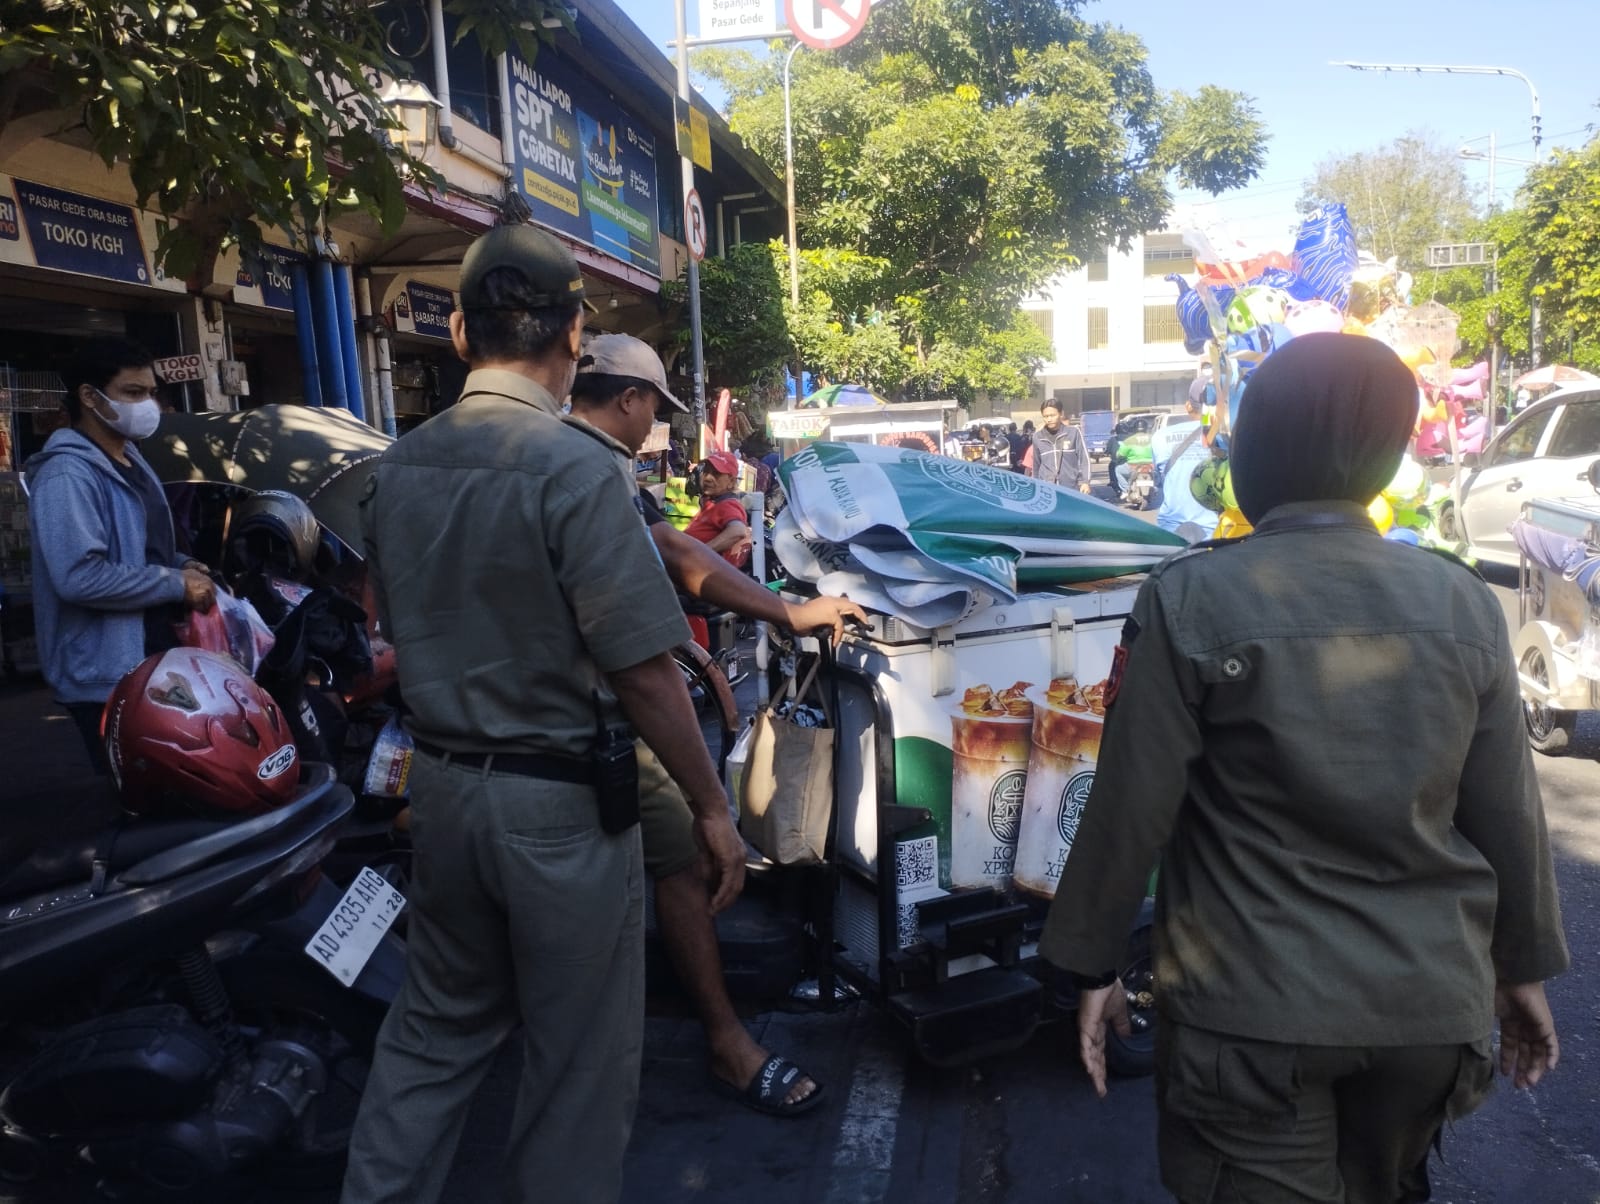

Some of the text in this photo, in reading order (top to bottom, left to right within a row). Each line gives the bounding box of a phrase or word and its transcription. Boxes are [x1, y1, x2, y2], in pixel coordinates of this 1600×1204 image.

[711, 13, 764, 28] Pasar Gede
[512, 56, 573, 114] MAU LAPOR
[515, 82, 553, 140] SPT
[518, 129, 577, 184] CORETAX
[28, 193, 129, 227] PASAR GEDE ORA SARE
[42, 221, 124, 255] TOKO KGH
[414, 311, 436, 325] SABAR
[158, 356, 200, 371] TOKO
[163, 368, 200, 382] KGH
[265, 750, 291, 772] VOG
[313, 870, 385, 963] AD 4335 AHG
